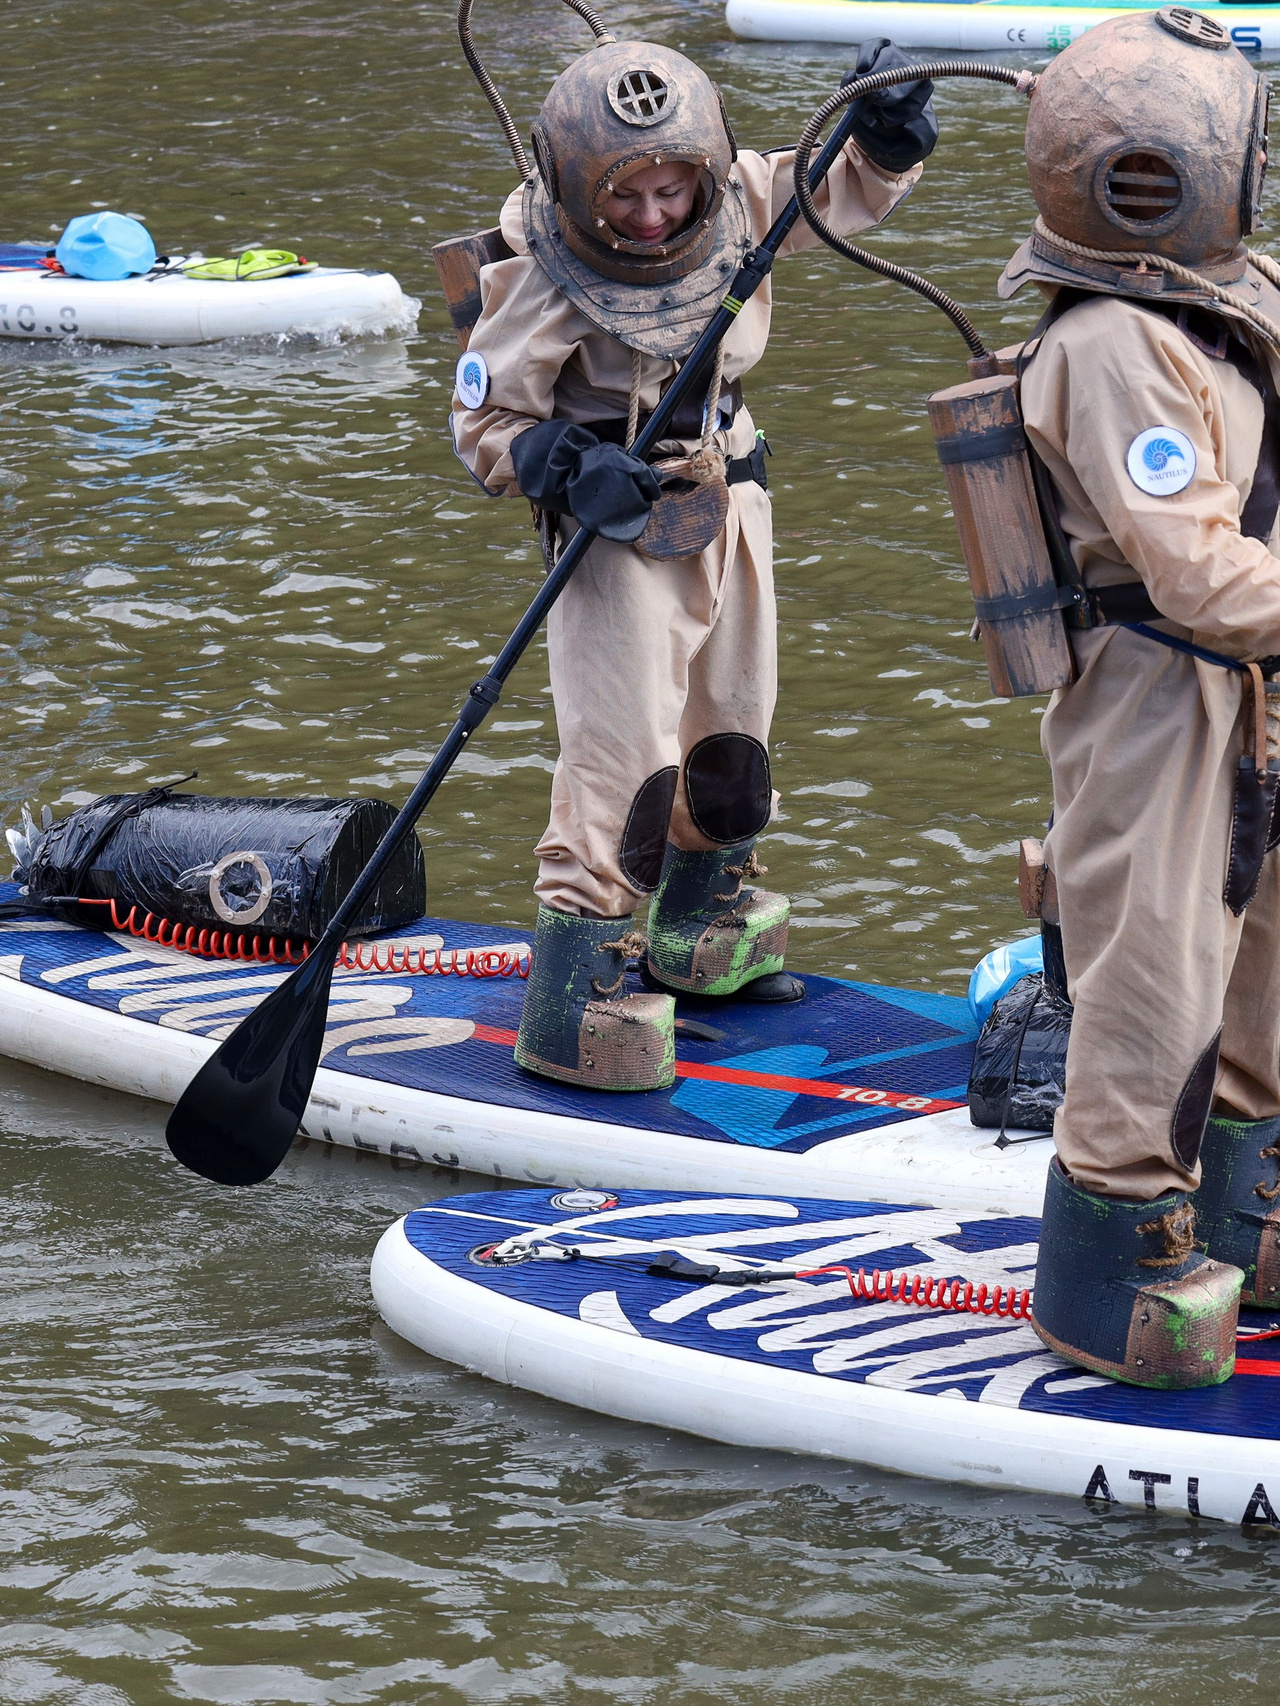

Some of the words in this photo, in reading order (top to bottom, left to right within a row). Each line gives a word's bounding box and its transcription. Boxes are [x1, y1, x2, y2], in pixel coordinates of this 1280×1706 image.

[1225, 26, 1262, 51] S
[1147, 468, 1188, 482] NAUTILUS
[836, 1087, 933, 1109] 10.8
